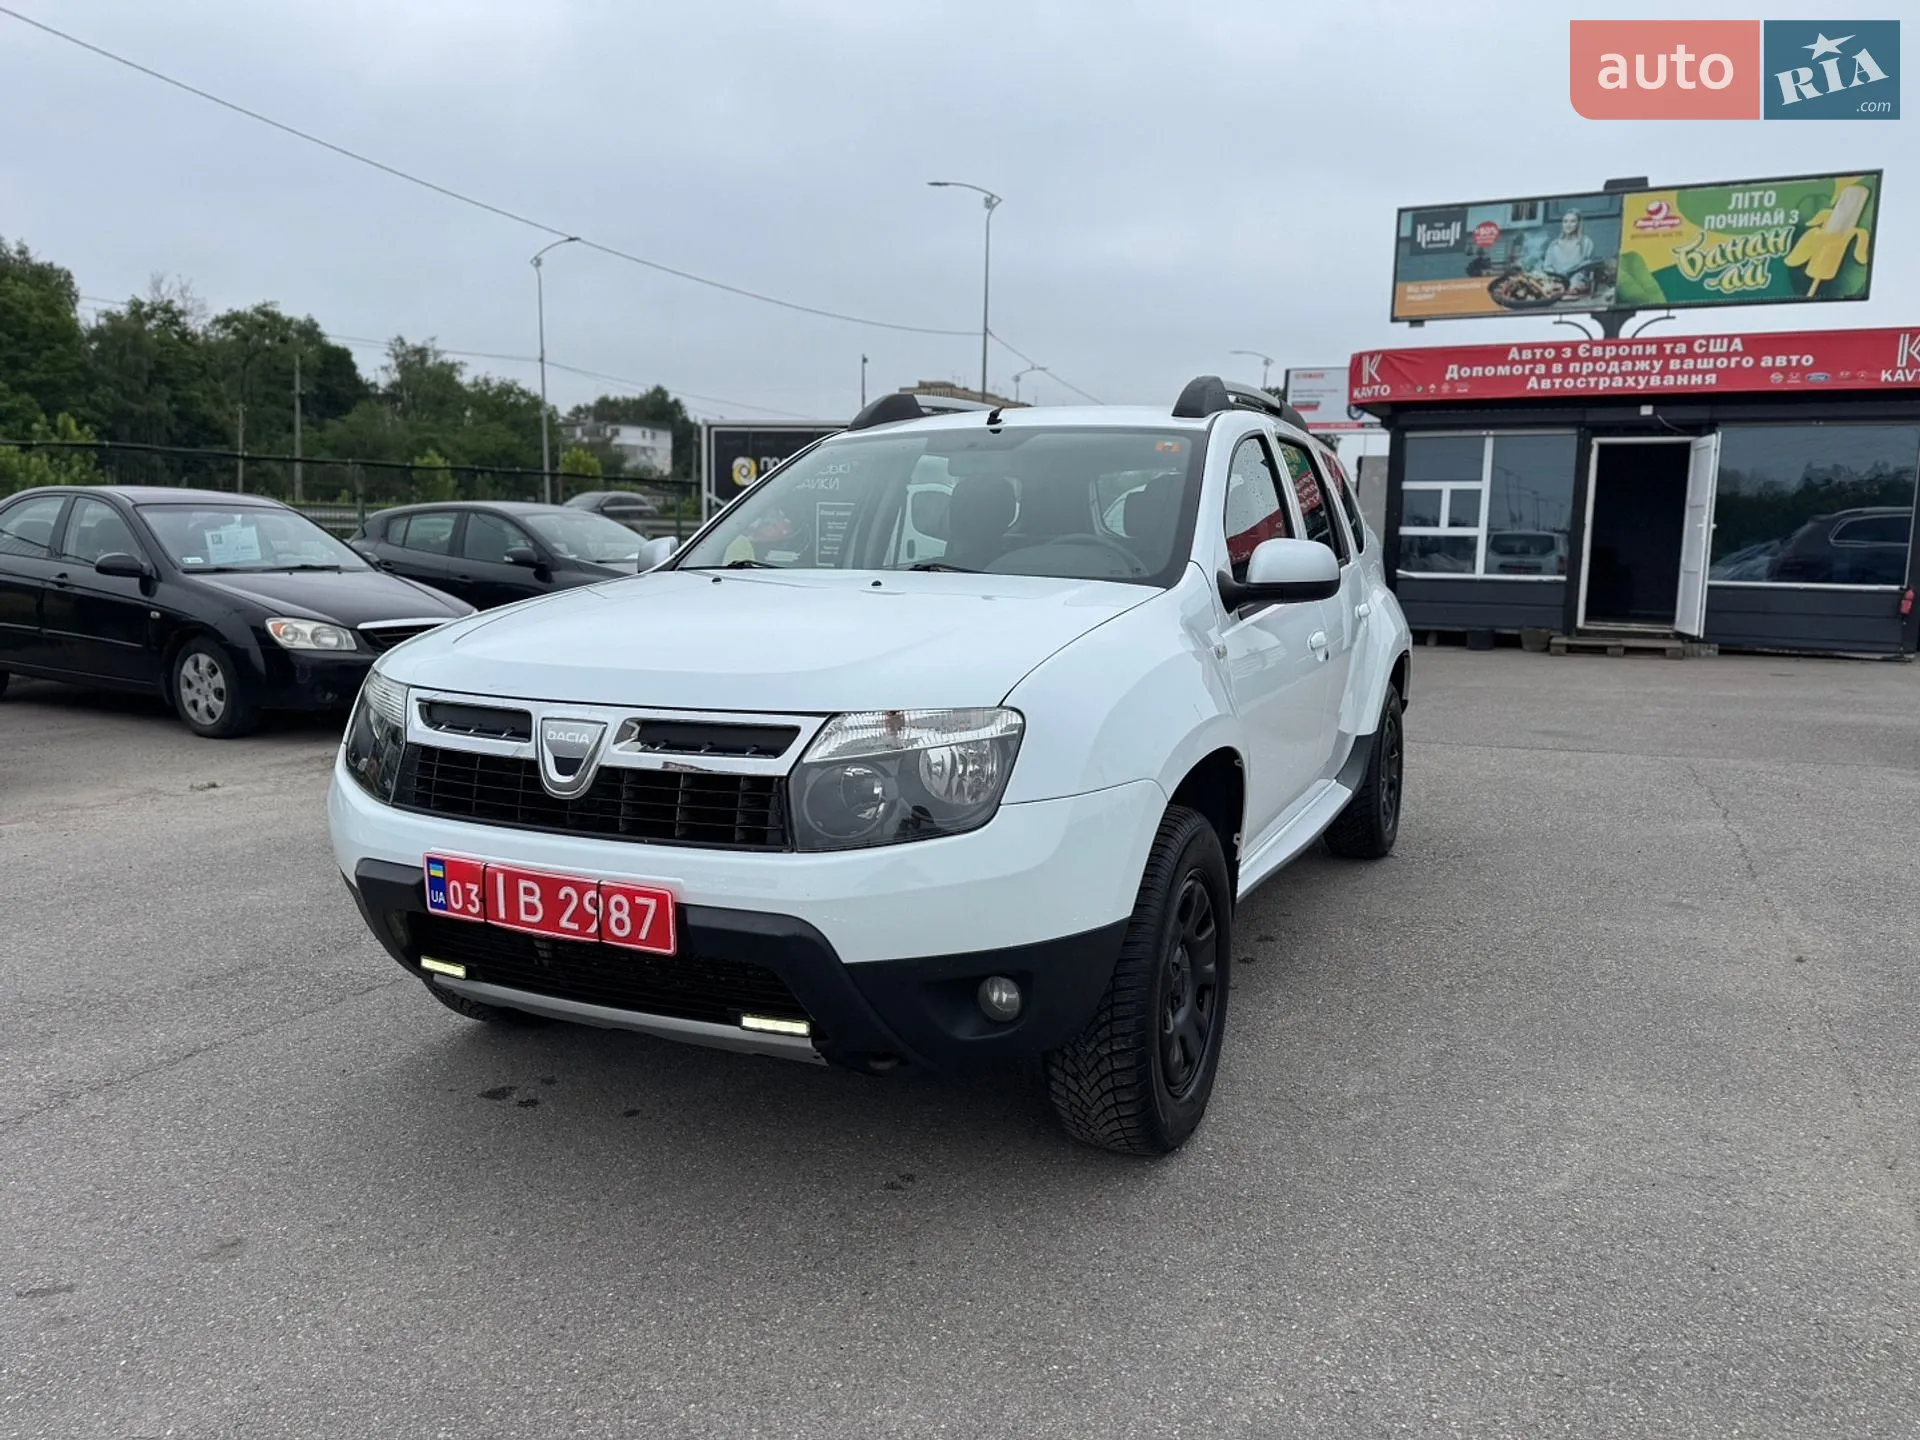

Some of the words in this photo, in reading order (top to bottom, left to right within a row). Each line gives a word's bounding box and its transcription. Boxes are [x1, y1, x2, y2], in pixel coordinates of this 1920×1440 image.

[1728, 190, 1777, 210] ЛІТО
[1704, 208, 1785, 230] ПОЧИНАЙ
[1507, 346, 1556, 361] Авто
[1561, 346, 1572, 358] з
[1577, 343, 1657, 359] Європи
[1663, 342, 1688, 354] та
[1693, 337, 1744, 353] США
[1361, 353, 1383, 385] K
[1444, 362, 1546, 381] Допомога
[1552, 362, 1563, 374] в
[1569, 359, 1664, 374] продажу
[1669, 355, 1754, 370] вашого
[1760, 354, 1815, 368] авто
[1353, 384, 1392, 399] KAVTO
[1526, 372, 1718, 390] Автострахування
[547, 730, 590, 744] DACIA
[430, 889, 446, 904] UA
[449, 880, 480, 913] 03
[496, 873, 544, 924] IB
[558, 886, 658, 940] 2987
